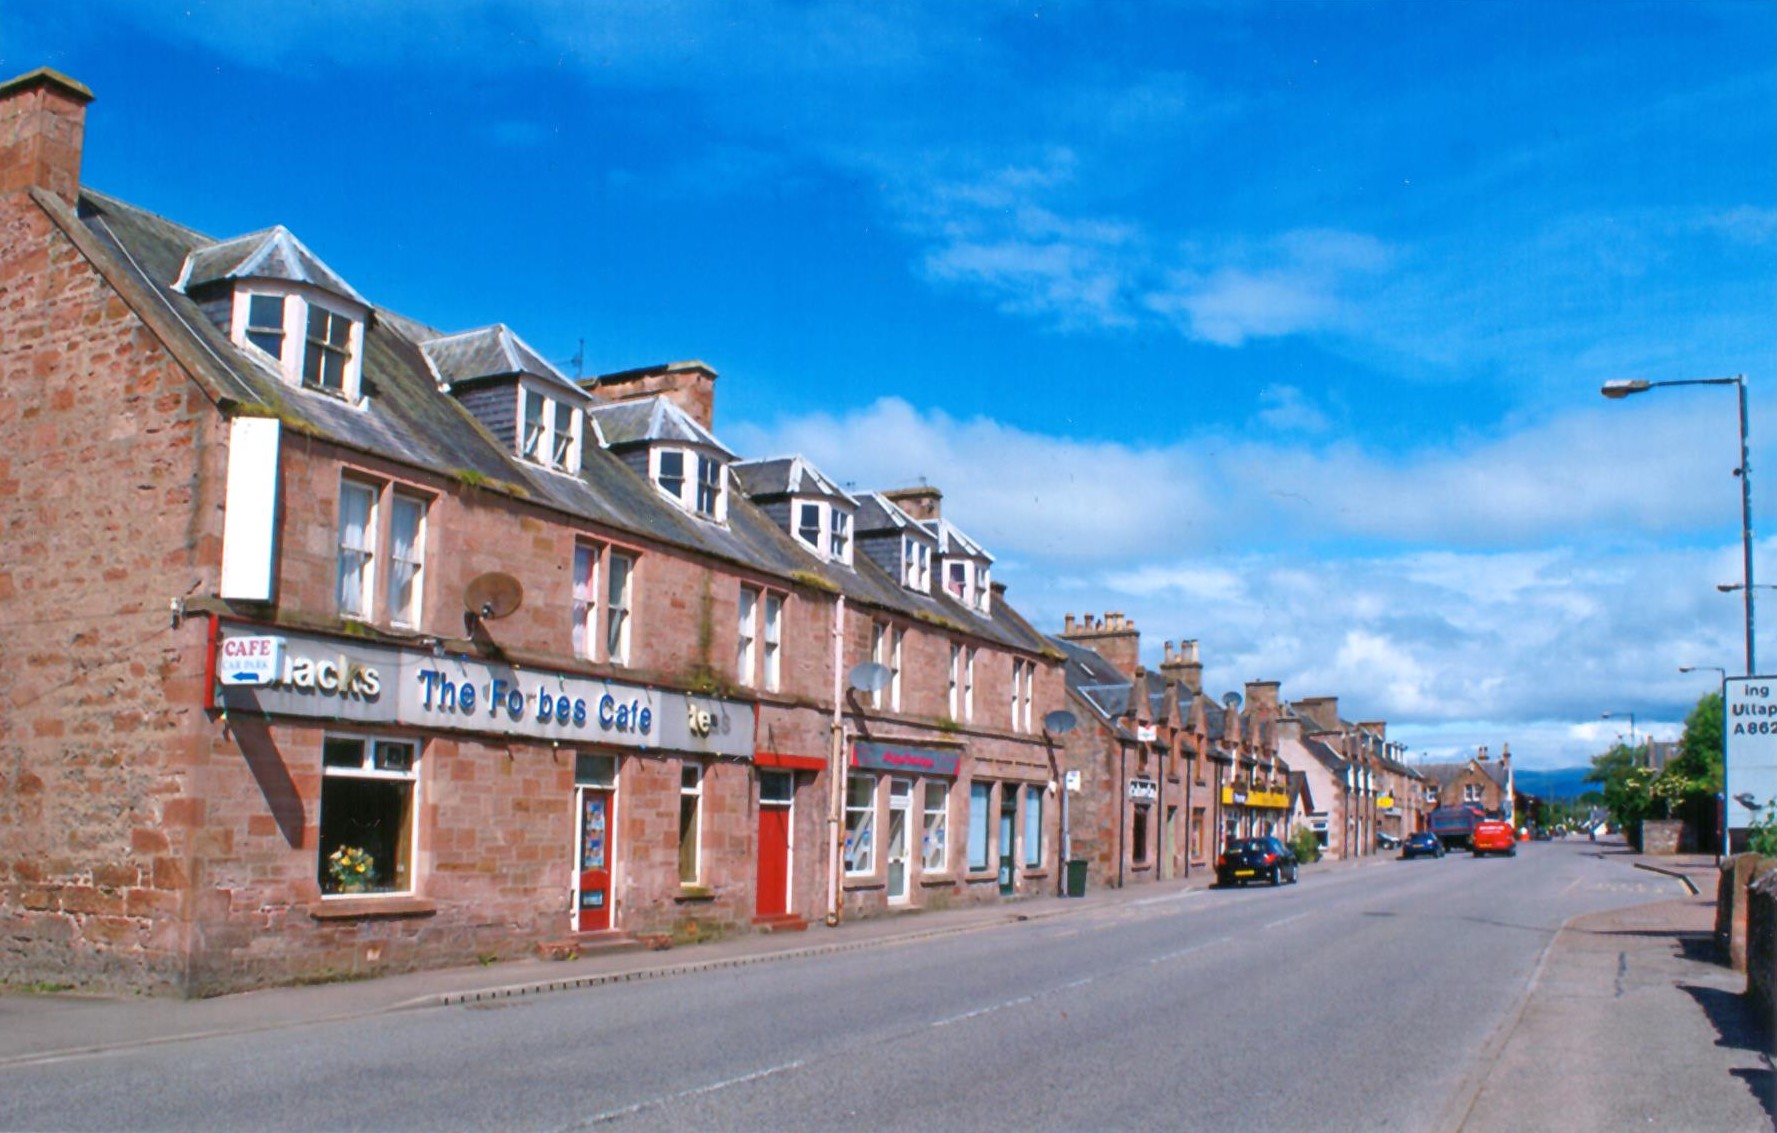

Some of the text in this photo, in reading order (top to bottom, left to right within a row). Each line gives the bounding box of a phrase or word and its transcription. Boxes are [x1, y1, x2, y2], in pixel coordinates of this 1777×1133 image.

[225, 640, 271, 656] CAFE
[419, 669, 476, 709] The
[599, 693, 653, 731] Cafe
[1734, 721, 1777, 735] A862
